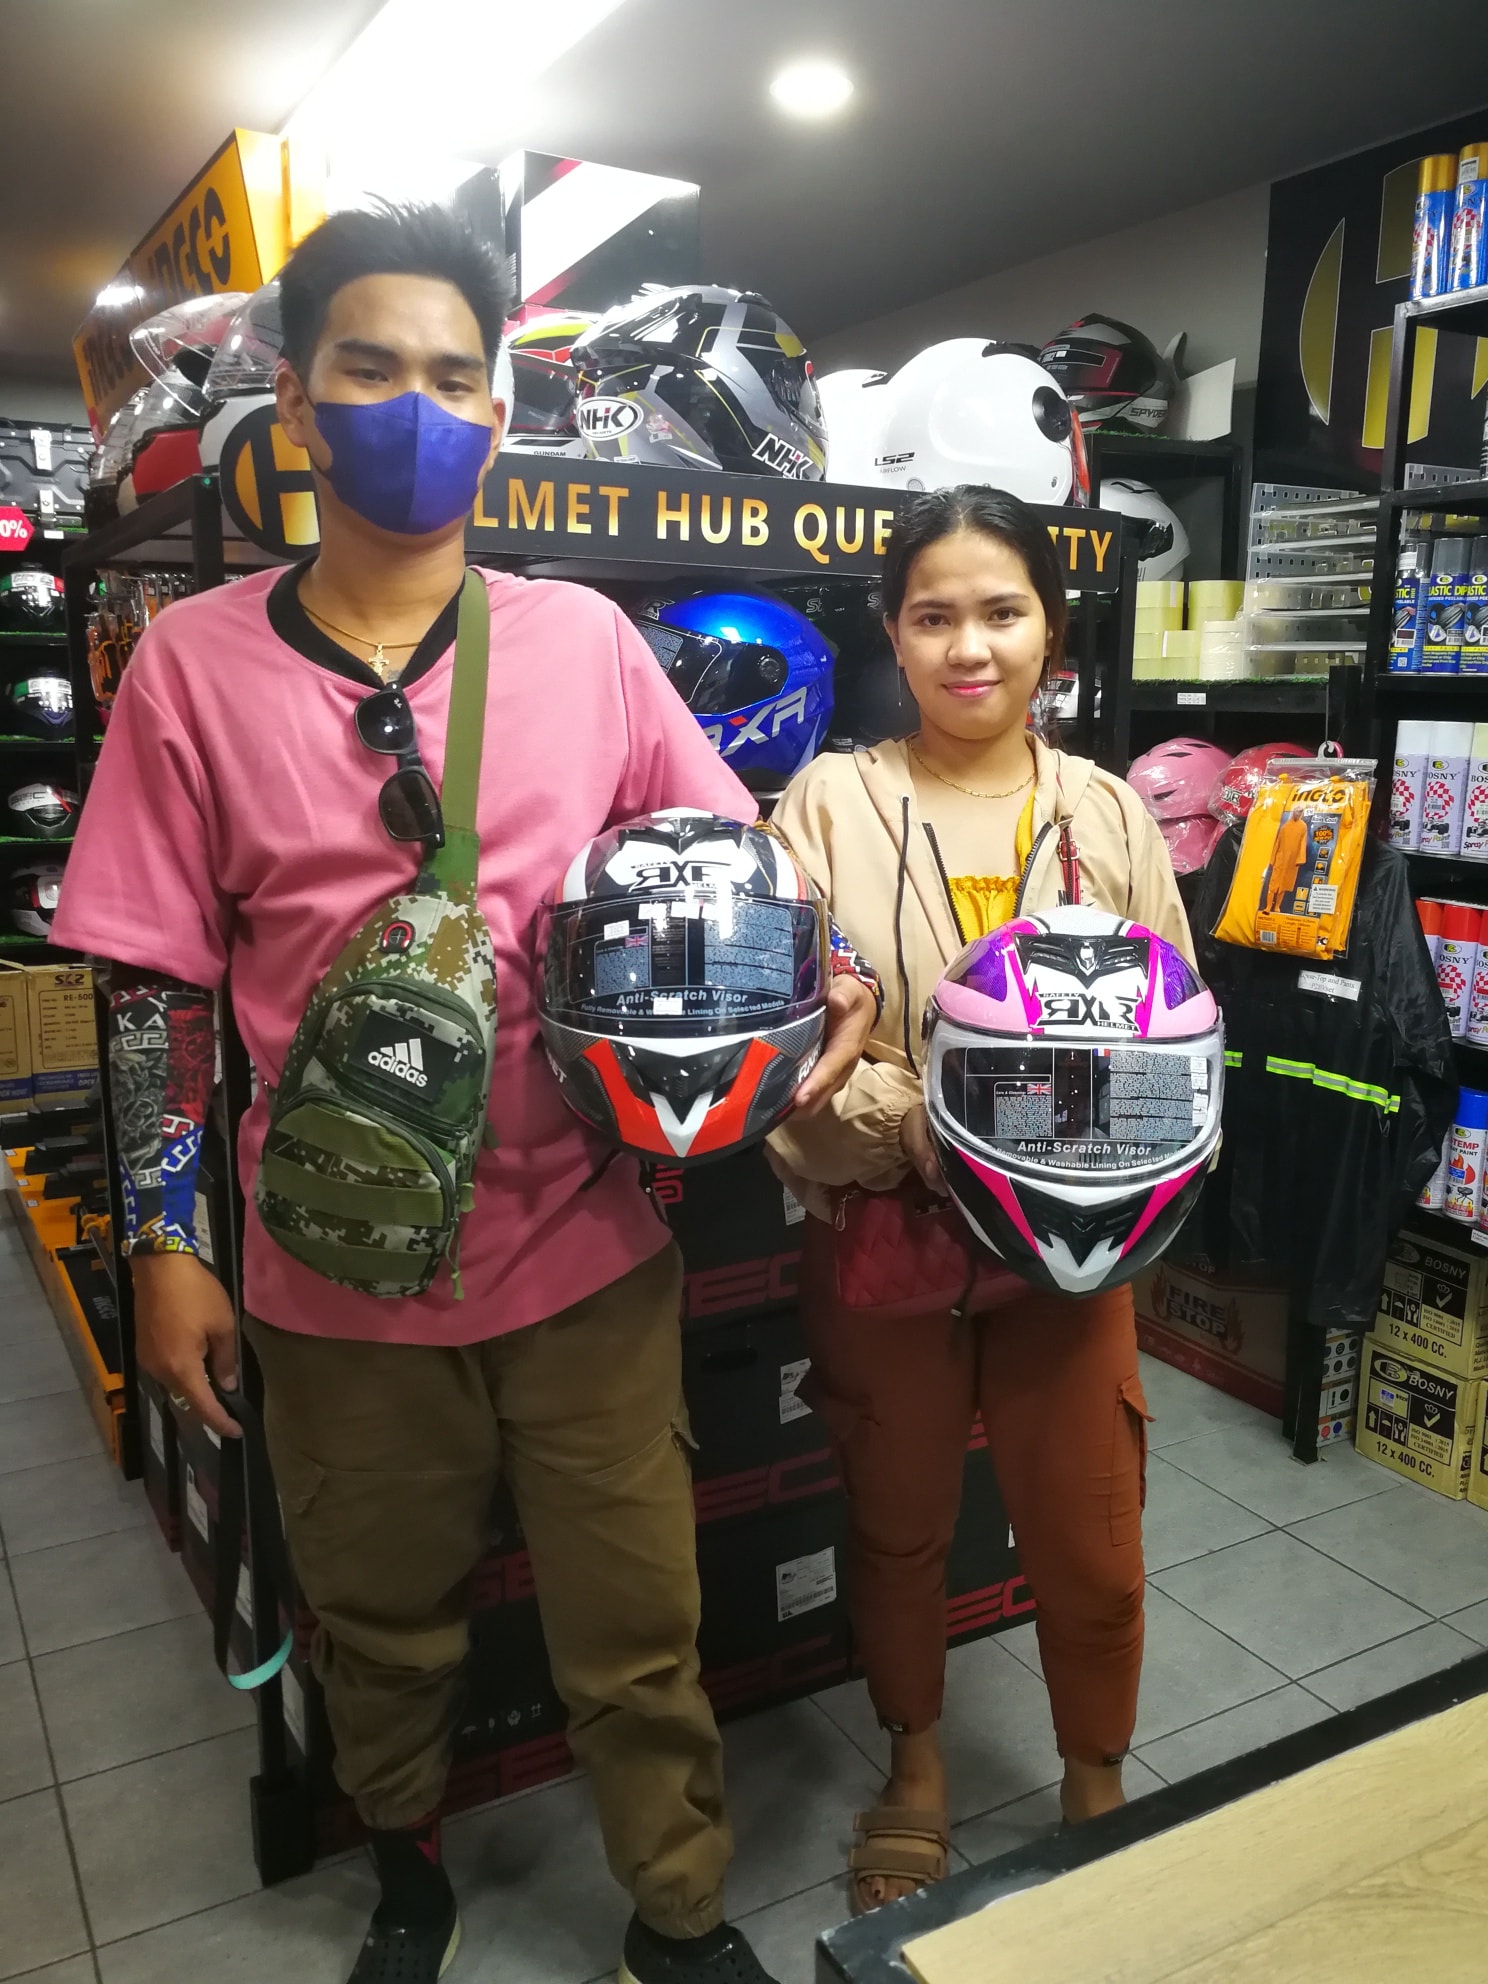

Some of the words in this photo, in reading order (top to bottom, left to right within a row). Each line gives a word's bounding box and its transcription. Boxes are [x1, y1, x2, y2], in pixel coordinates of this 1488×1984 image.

[874, 452, 915, 466] LS2
[473, 478, 629, 536] LMET
[657, 490, 770, 546] HUB
[794, 503, 894, 564] QUE
[1047, 526, 1113, 573] TY
[1428, 772, 1456, 781] OSNY
[1470, 775, 1488, 783] BOS
[1440, 955, 1470, 965] OSNY
[712, 990, 748, 1003] Visor
[581, 1003, 596, 1012] Fully
[688, 1008, 713, 1016] Lining
[728, 1003, 761, 1014] Selected
[761, 999, 785, 1009] Models
[1097, 1020, 1138, 1032] HELMET
[367, 1050, 429, 1088] adidas
[1017, 1141, 1111, 1154] Anti-Scratch
[1116, 1143, 1151, 1155] Visor
[1048, 1159, 1090, 1169] Washable
[1091, 1162, 1117, 1170] Lining
[1131, 1156, 1164, 1166] Selected
[1424, 1256, 1467, 1279] BOSNY
[1168, 1285, 1225, 1318] FIRE
[1167, 1300, 1226, 1334] STOP
[1425, 1322, 1456, 1339] CERTIFIED
[1389, 1323, 1400, 1338] 12
[1402, 1331, 1409, 1341] x
[1410, 1333, 1429, 1350] 400
[1431, 1341, 1448, 1359] CC.
[1408, 1374, 1455, 1400] BOSNY
[1413, 1441, 1444, 1459] CERTIFIED
[1376, 1441, 1388, 1456] 12
[1389, 1448, 1396, 1459] x
[1398, 1450, 1416, 1469] 400
[1418, 1460, 1435, 1478] CC.
